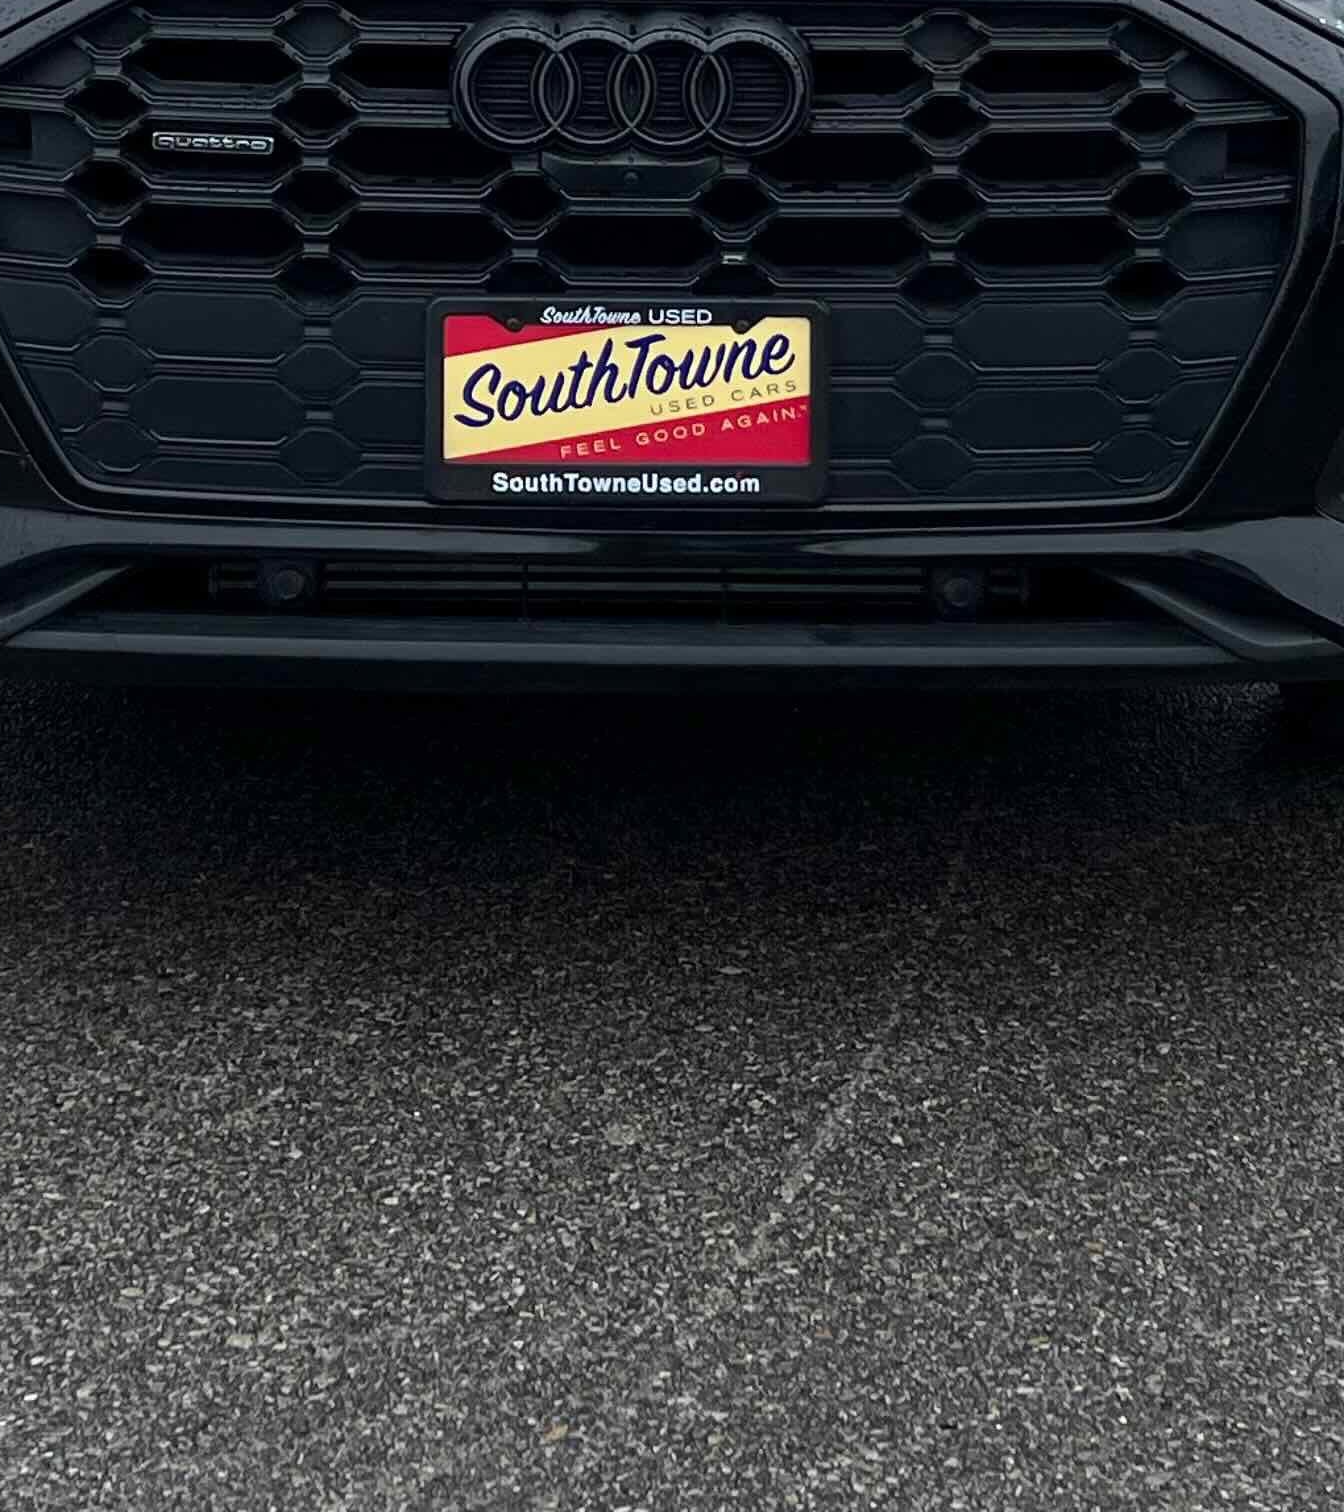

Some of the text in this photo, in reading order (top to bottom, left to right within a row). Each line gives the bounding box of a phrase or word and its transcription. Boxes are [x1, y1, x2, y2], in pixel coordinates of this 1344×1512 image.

[158, 136, 267, 150] quattro
[539, 305, 713, 325] SouthTowne USED
[454, 333, 796, 427] SouthTowne
[650, 380, 797, 416] USED CARS
[560, 437, 621, 460] FEEL
[636, 423, 706, 446] GOOD
[492, 472, 760, 494] SouthTowneUsed.com
